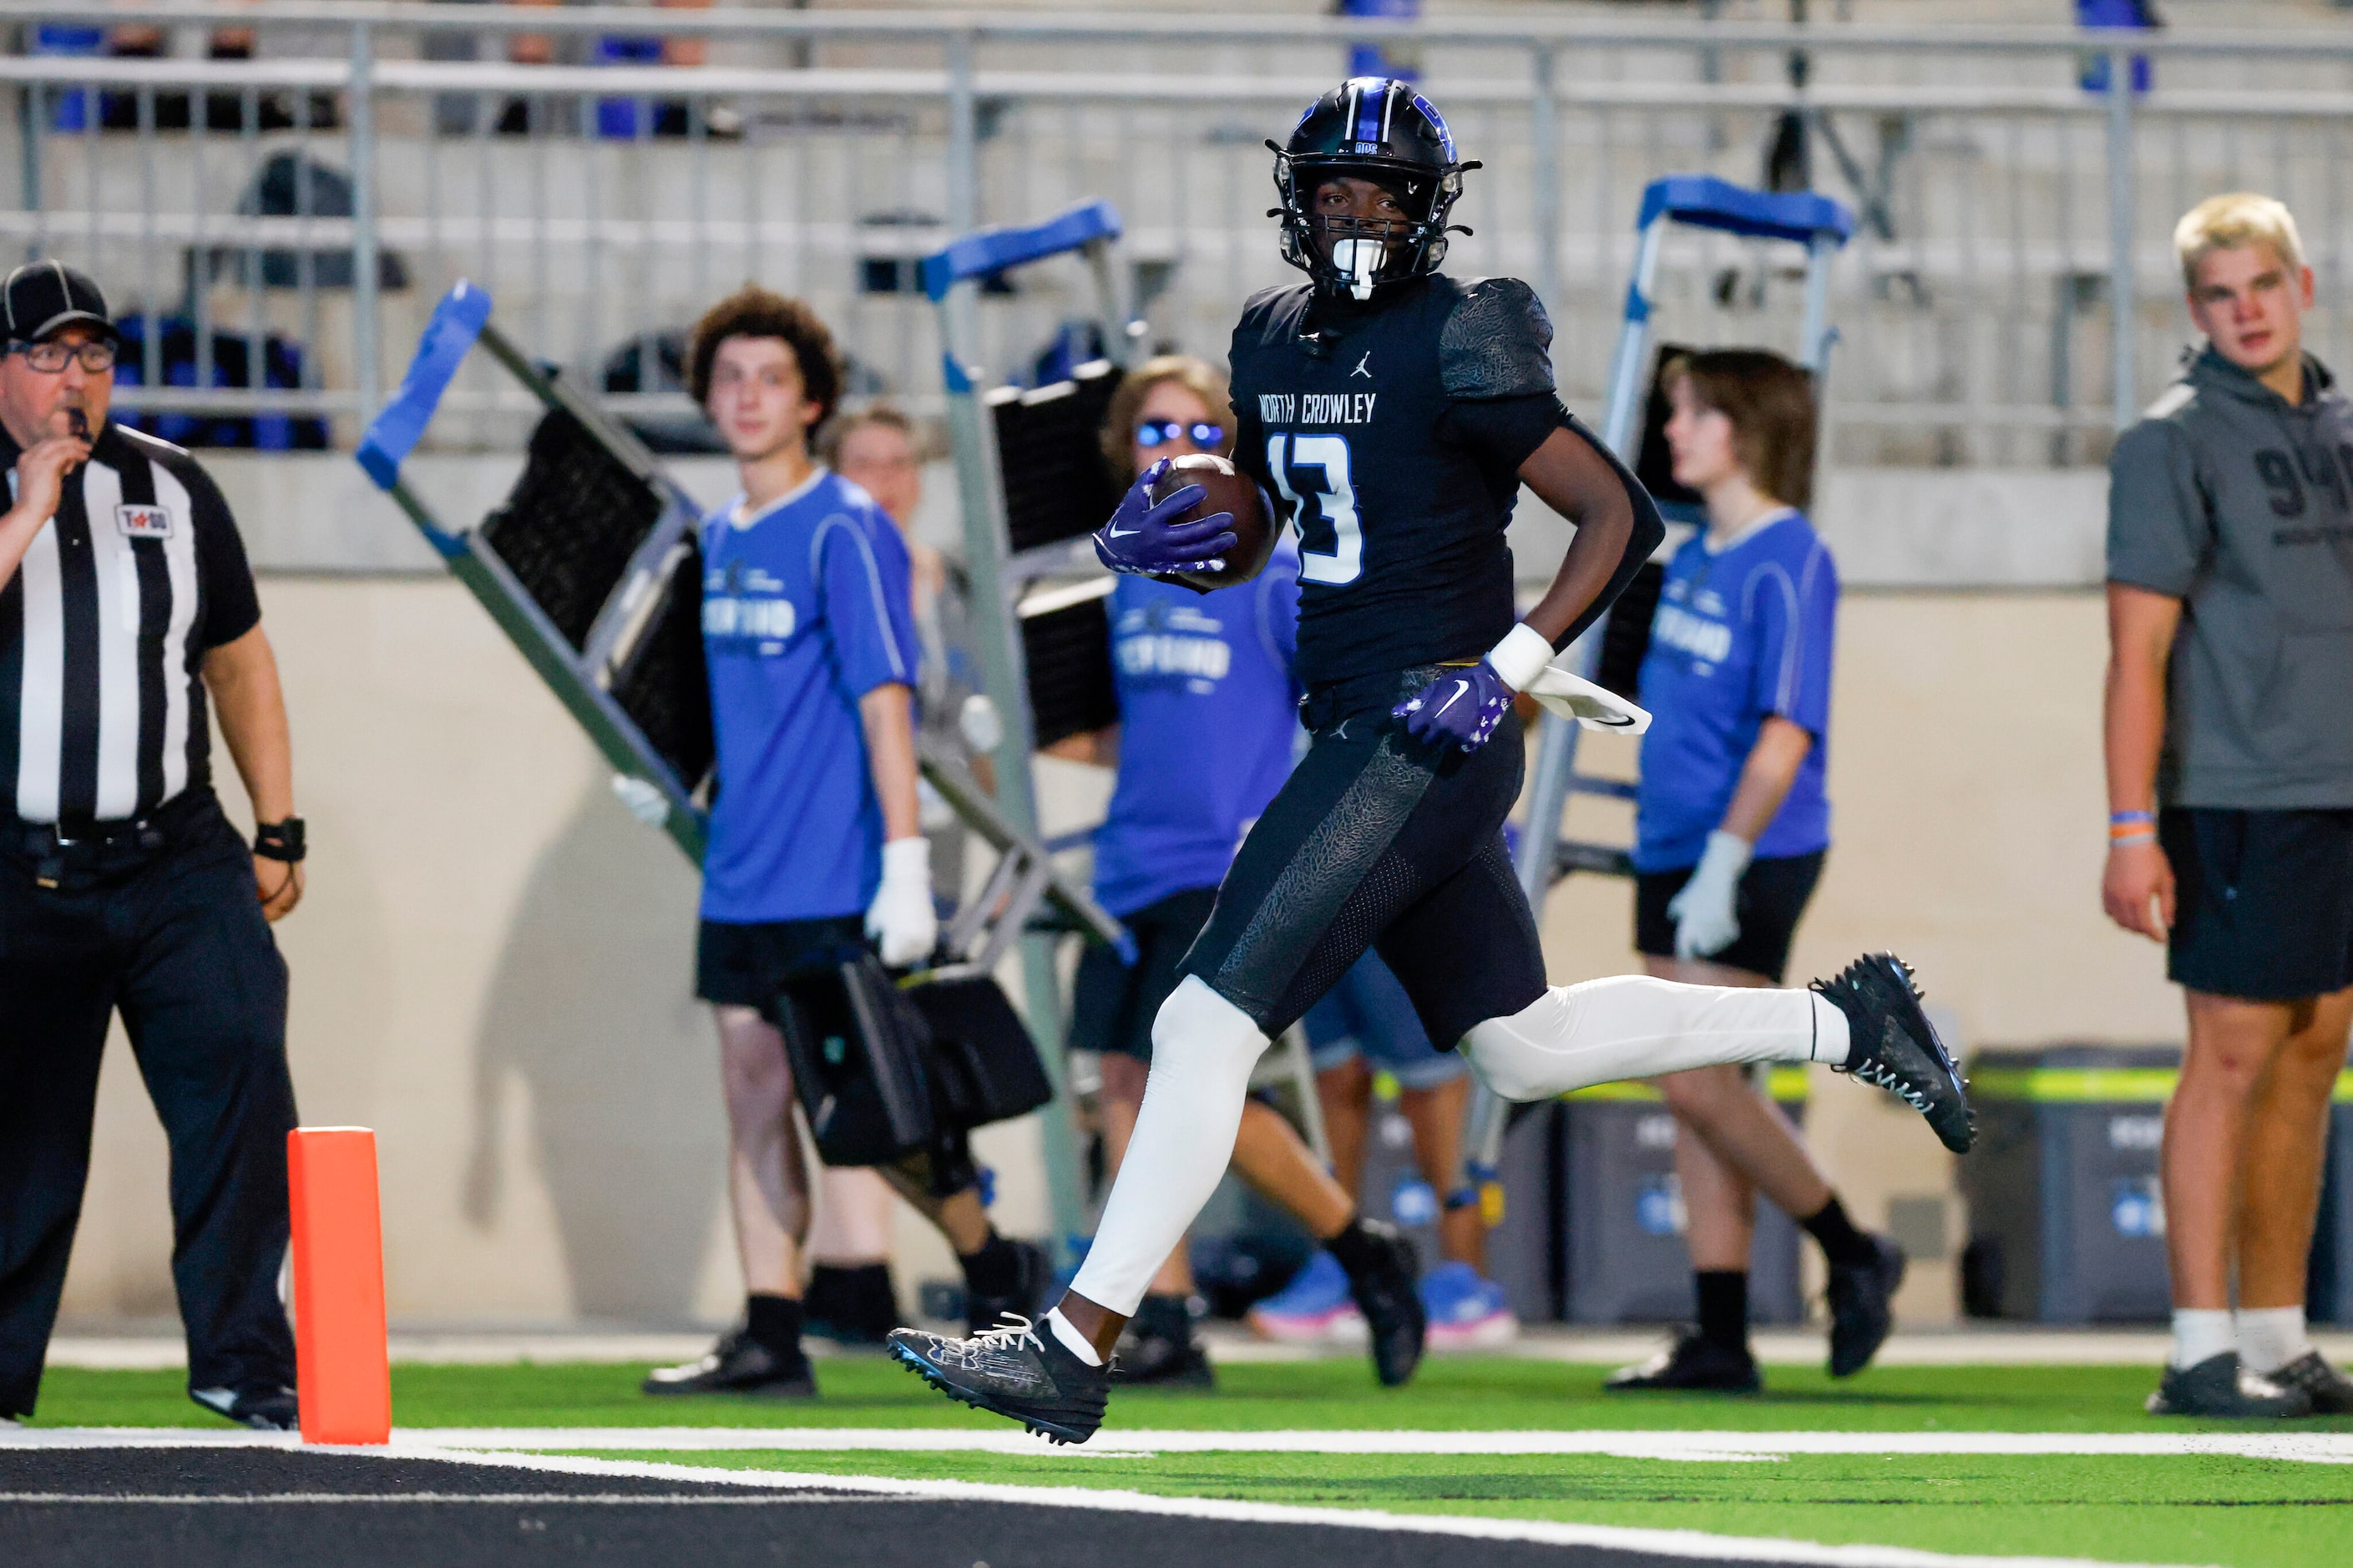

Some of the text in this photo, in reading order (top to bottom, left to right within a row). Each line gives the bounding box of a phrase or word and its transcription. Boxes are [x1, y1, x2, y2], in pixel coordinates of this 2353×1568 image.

[1257, 392, 1377, 424] NORTH CROWLEY
[1266, 432, 1366, 587] 13
